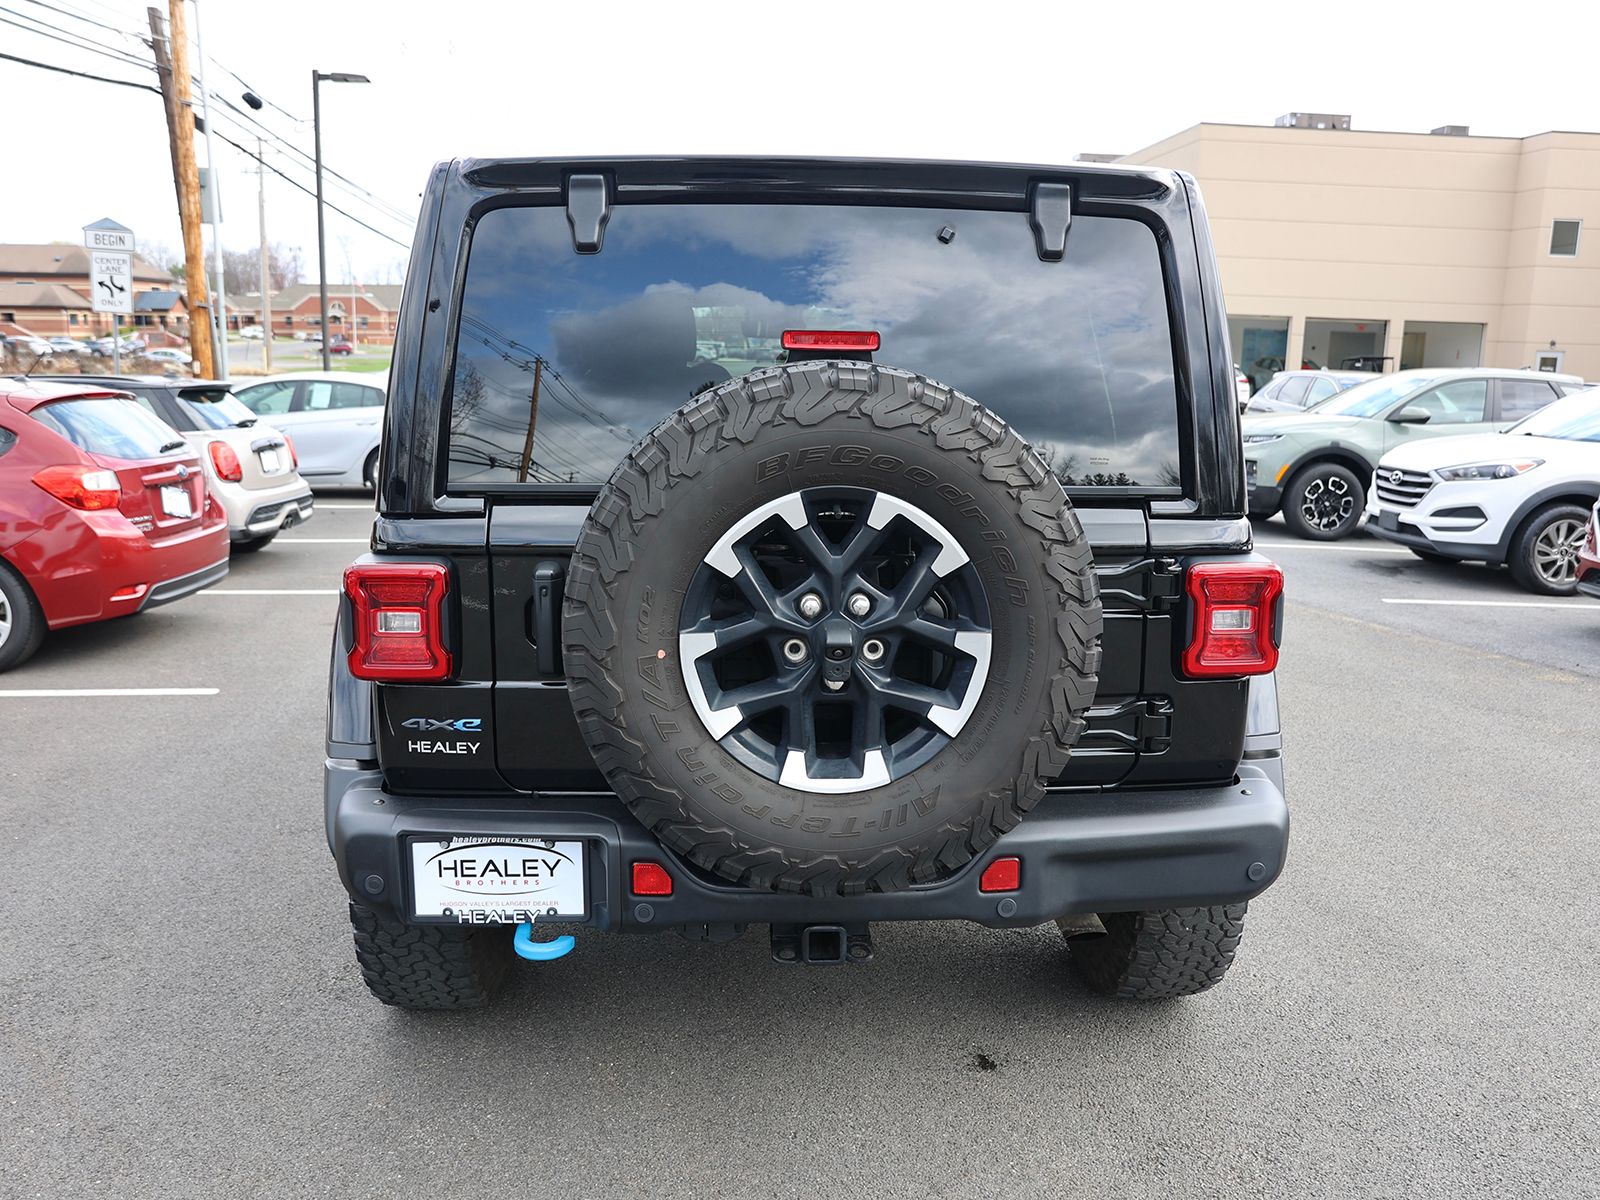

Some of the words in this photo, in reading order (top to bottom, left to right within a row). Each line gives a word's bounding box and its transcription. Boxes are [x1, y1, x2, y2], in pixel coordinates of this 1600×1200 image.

[94, 234, 125, 246] BEGIN
[94, 257, 127, 265] CENTER
[100, 265, 122, 273] LANE
[101, 299, 123, 307] ONLY
[408, 740, 481, 755] HEALEY
[452, 836, 542, 846] healeybrothers.com
[438, 859, 562, 878] HEALEY
[458, 910, 541, 925] HEALEY
